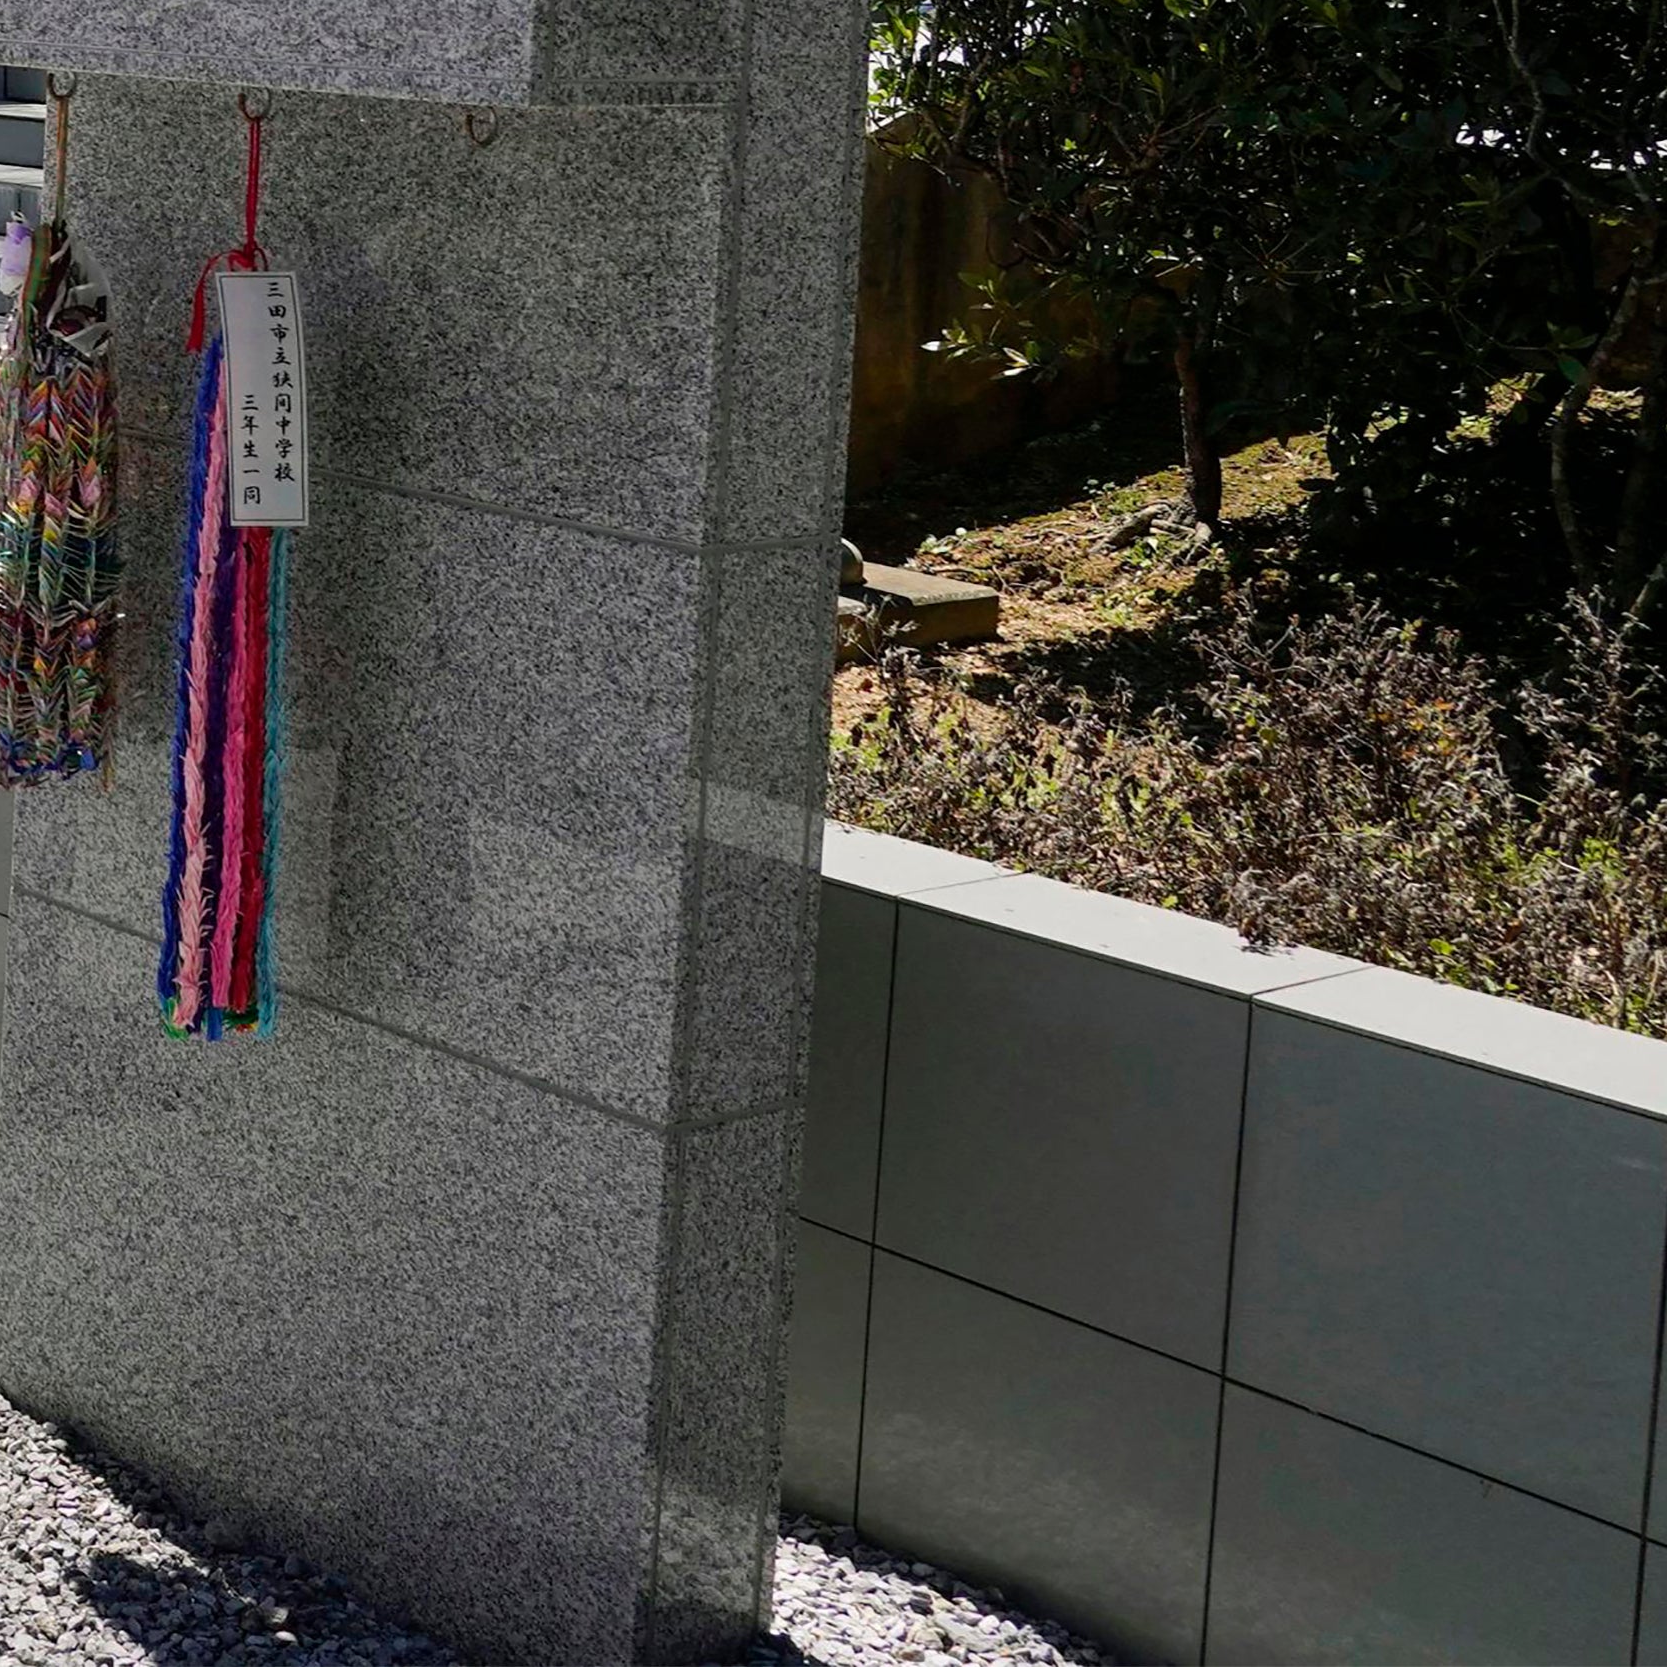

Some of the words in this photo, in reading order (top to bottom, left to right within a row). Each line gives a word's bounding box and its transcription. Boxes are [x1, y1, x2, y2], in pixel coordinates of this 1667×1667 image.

[240, 395, 261, 505] 三年生一同
[267, 282, 295, 482] 三田市立狭間中学校
